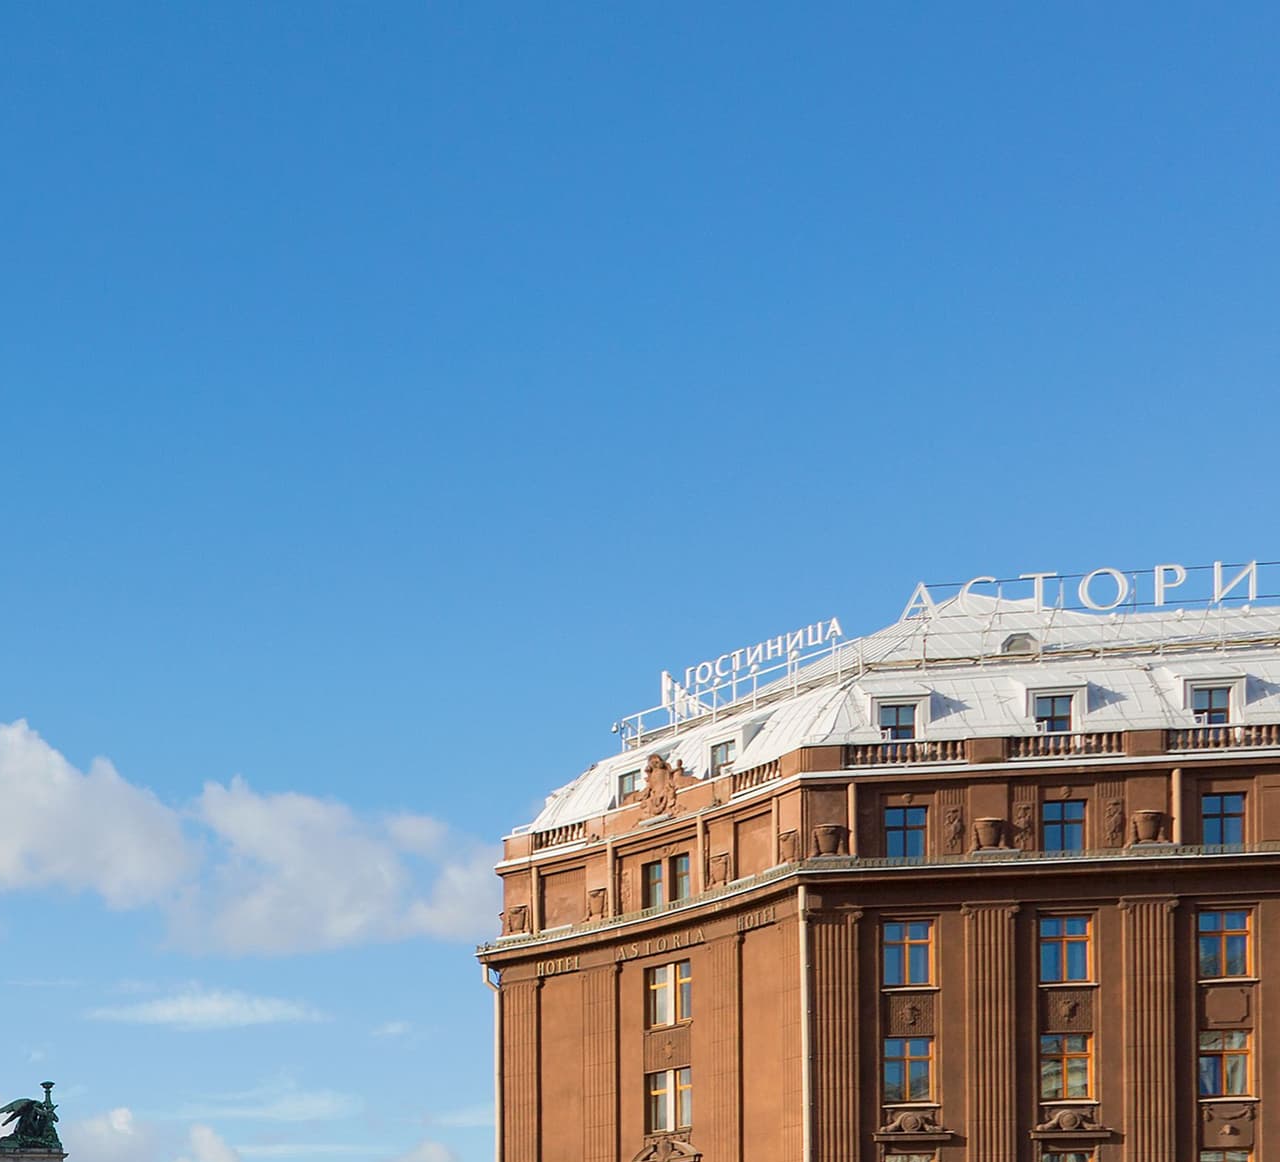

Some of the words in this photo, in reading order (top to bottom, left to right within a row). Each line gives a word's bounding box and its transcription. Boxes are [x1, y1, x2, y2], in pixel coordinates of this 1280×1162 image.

[898, 560, 1257, 623] АСТОРИ
[686, 617, 842, 688] ГОСТИНИЦА
[536, 957, 580, 977] HOTEL
[617, 929, 705, 962] ASTORIA
[737, 907, 777, 931] HOTEL
